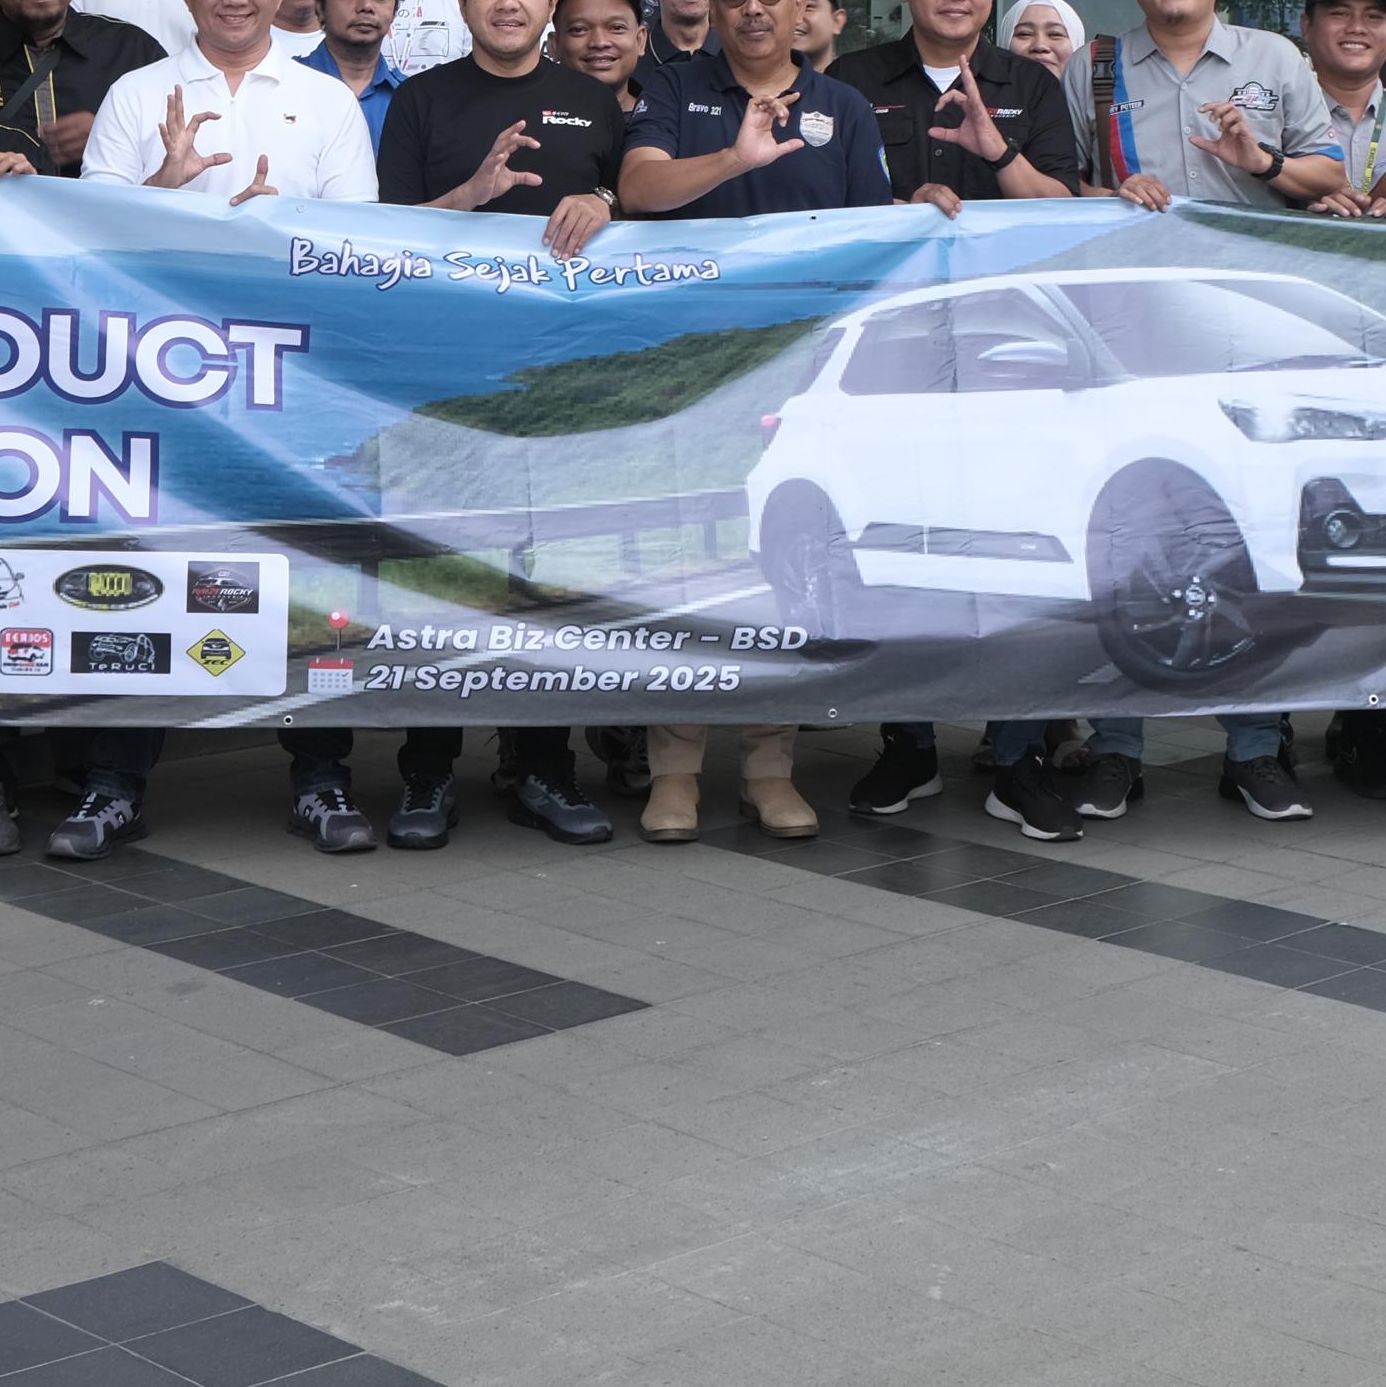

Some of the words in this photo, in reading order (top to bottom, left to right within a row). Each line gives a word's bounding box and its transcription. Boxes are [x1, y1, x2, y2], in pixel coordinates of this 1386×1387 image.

[688, 102, 709, 114] Bravo
[542, 115, 592, 128] Rocky
[290, 237, 434, 289] Bahagia
[447, 251, 552, 293] Sejak
[560, 253, 721, 290] Pertama
[4, 633, 48, 643] TERIOS
[367, 622, 477, 651] Astra
[487, 622, 548, 651] Biz
[553, 622, 686, 651] Center
[729, 624, 810, 651] BSD
[365, 664, 409, 691] 21
[413, 664, 636, 697] September
[644, 663, 742, 692] 2025
